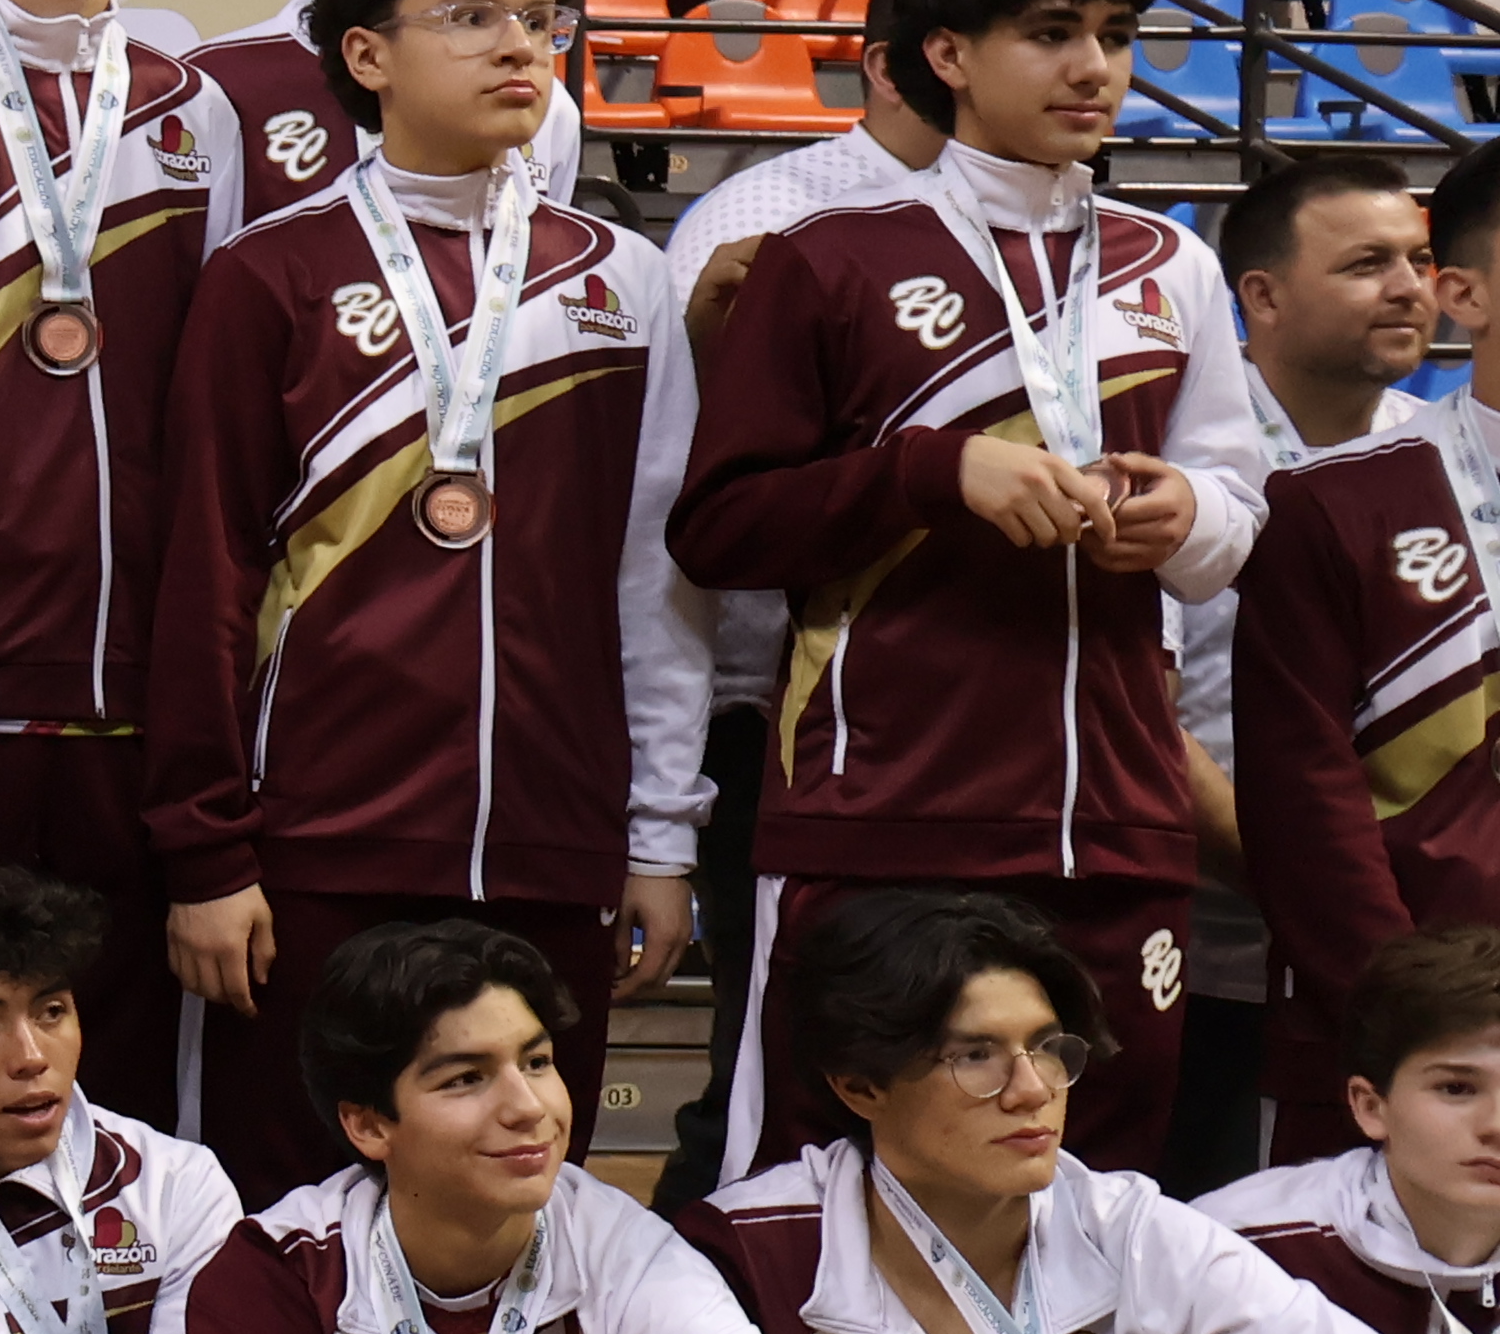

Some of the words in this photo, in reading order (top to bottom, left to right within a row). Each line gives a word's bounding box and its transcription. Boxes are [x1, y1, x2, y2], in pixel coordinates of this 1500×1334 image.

[24, 145, 52, 210] EDUCACIÓN
[262, 111, 331, 182] BC
[331, 281, 403, 358] BC
[566, 303, 639, 334] corazón
[889, 274, 969, 353] BC
[478, 316, 502, 380] EDUCACIÓN
[1392, 525, 1468, 604] BC
[1140, 927, 1184, 1012] BC
[608, 1087, 632, 1107] 03
[89, 1238, 156, 1265] orazón
[378, 1252, 405, 1305] CONADE
[962, 1280, 1004, 1334] EDUCACIÓN
